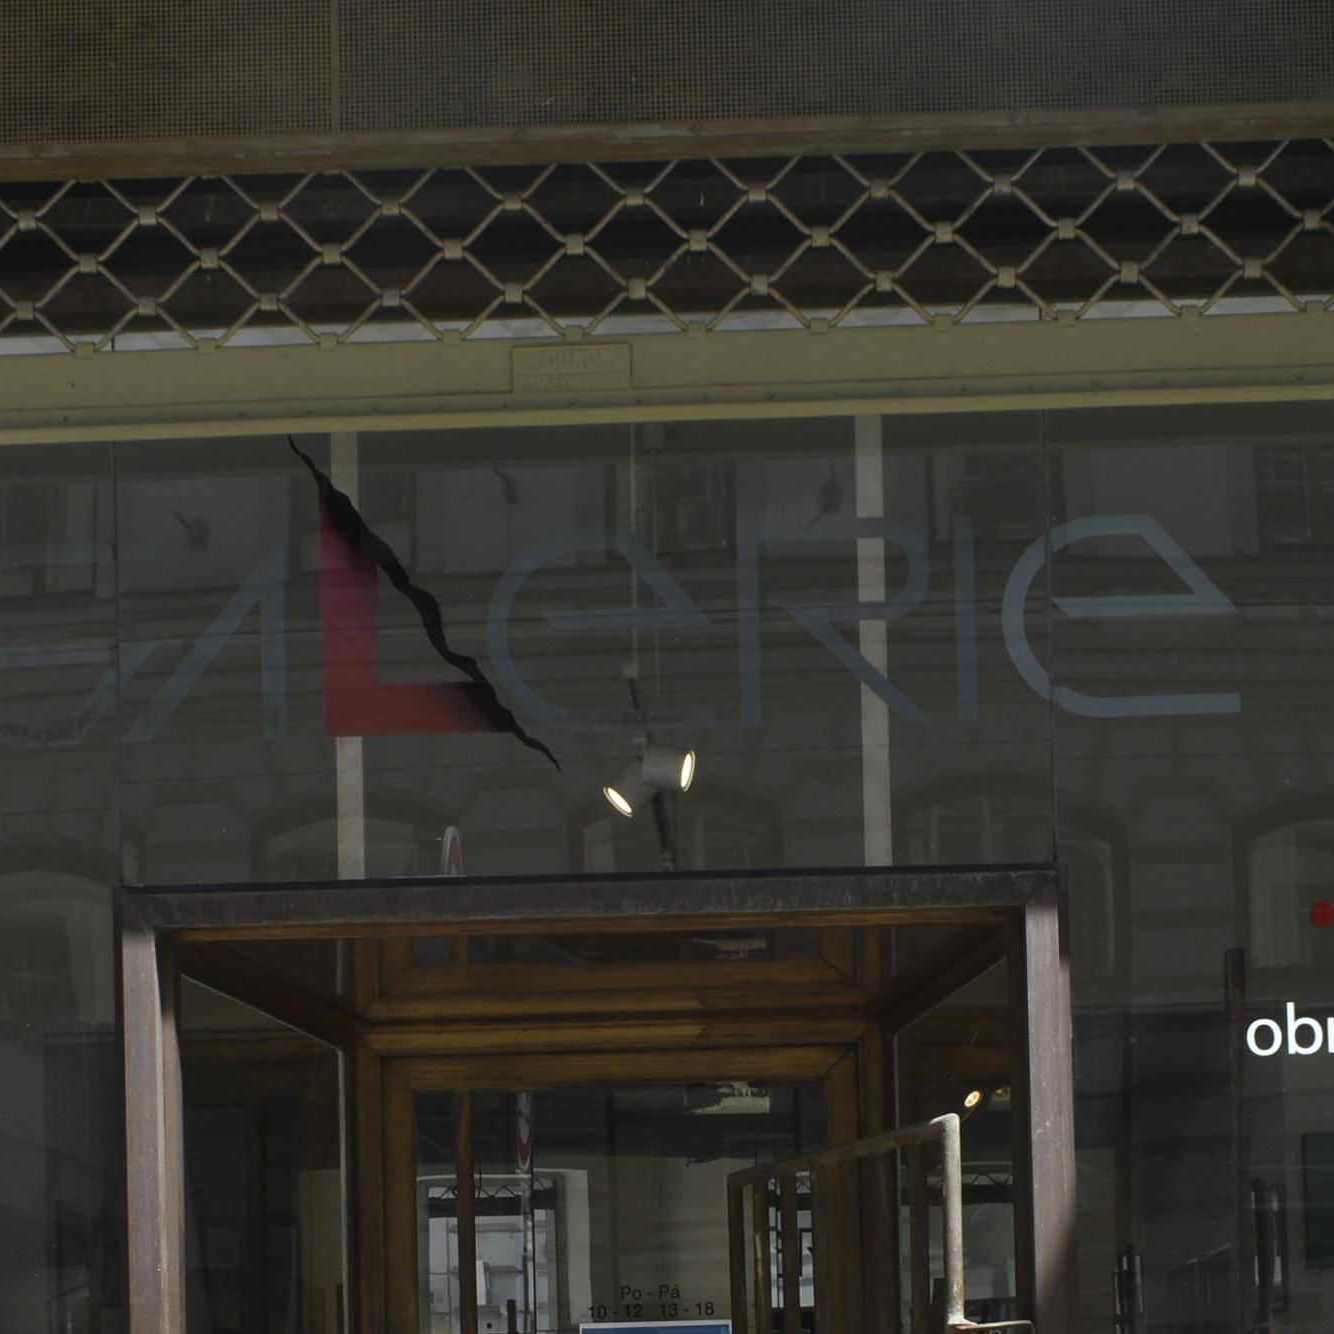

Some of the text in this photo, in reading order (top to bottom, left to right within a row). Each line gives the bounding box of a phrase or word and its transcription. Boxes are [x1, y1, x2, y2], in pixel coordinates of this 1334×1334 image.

[620, 1286, 642, 1300] Po
[658, 1284, 681, 1299] Pá
[588, 1305, 607, 1320] 10
[624, 1304, 644, 1318] 12
[659, 1303, 679, 1317] 13
[695, 1302, 715, 1316] 18
